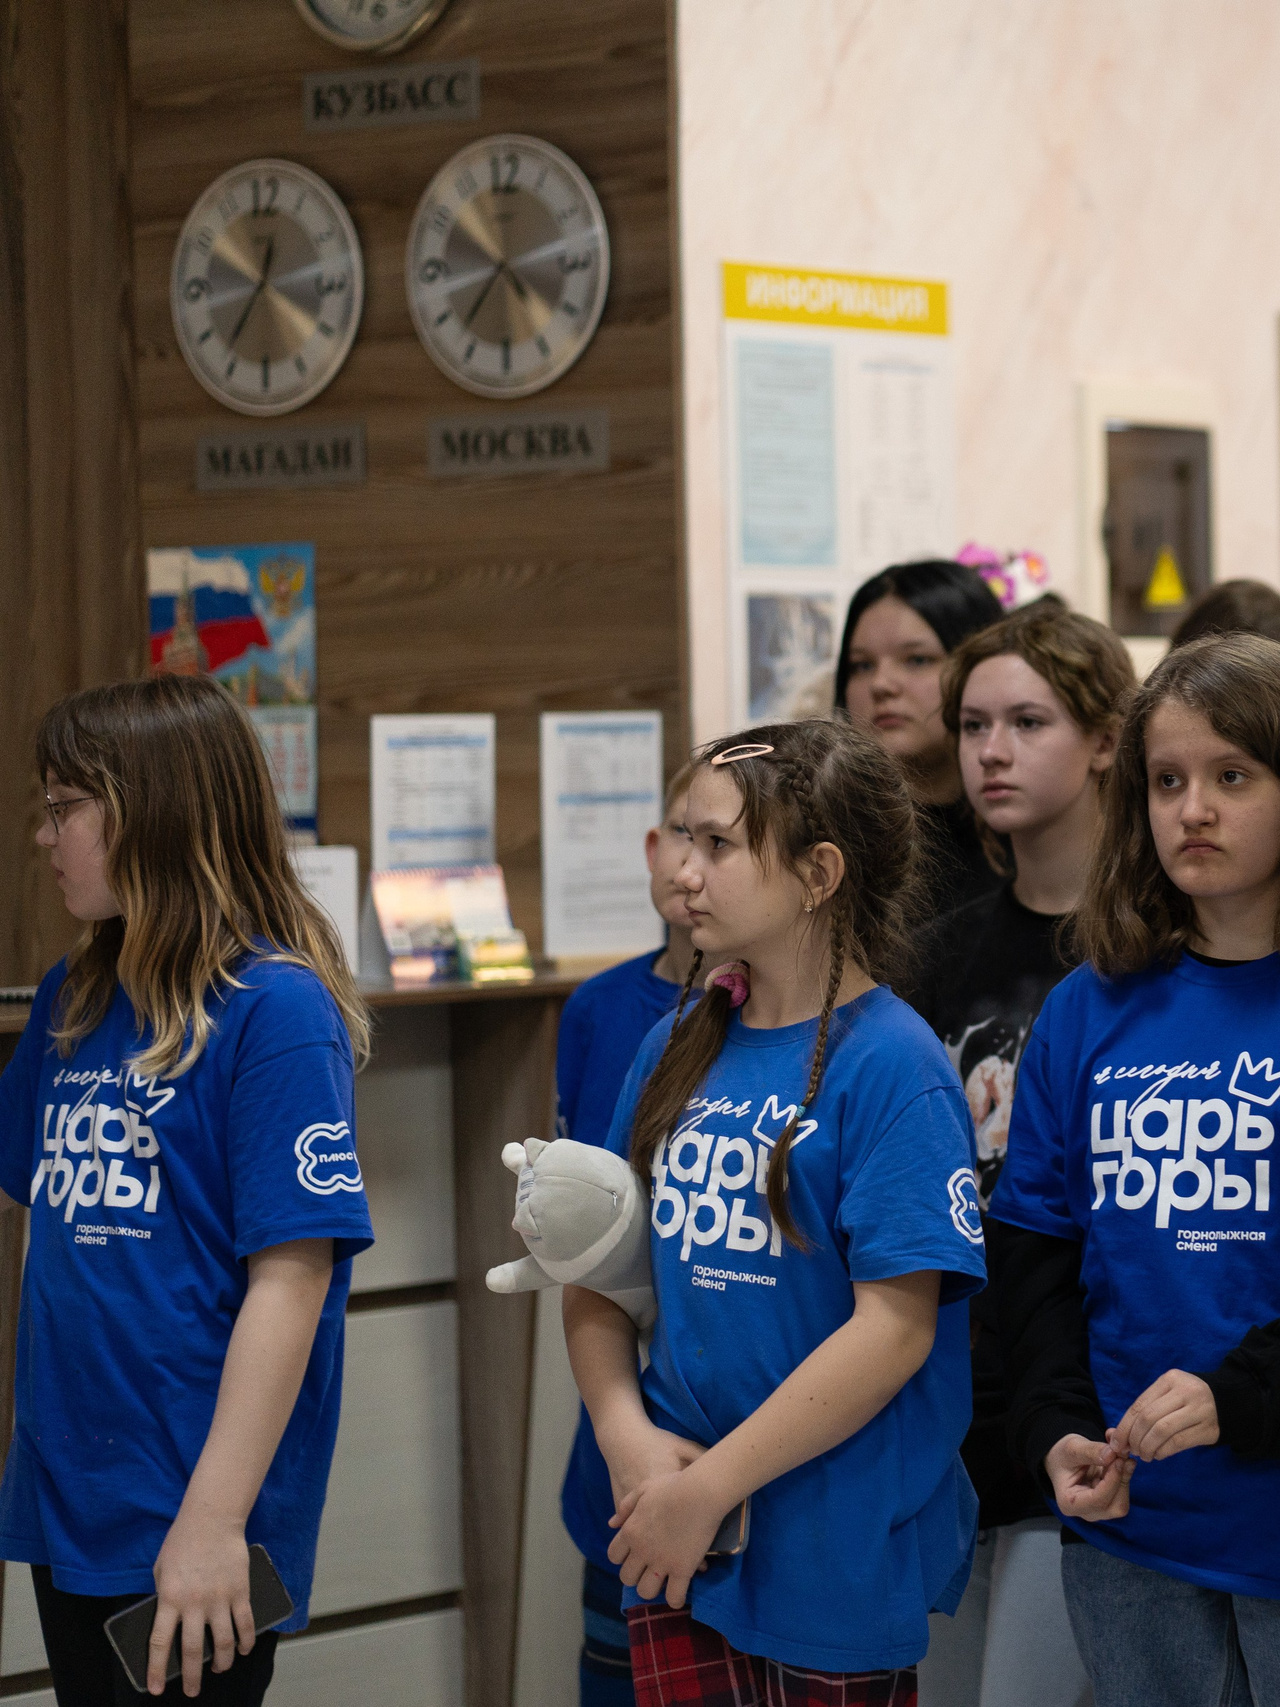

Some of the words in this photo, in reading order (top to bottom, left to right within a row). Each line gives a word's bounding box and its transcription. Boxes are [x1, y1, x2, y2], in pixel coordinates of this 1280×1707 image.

[312, 70, 472, 120] КУЗБАСС
[490, 152, 521, 194] 12
[251, 175, 280, 218] 12
[419, 257, 451, 284] 9
[557, 250, 592, 274] 3
[184, 276, 214, 302] 9
[314, 272, 347, 297] 3
[745, 271, 929, 325] ИНФОРМАЦИЯ
[206, 435, 354, 476] МАГАДАН
[440, 421, 595, 464] МОСКВА
[1093, 1066, 1113, 1085] я
[1114, 1061, 1222, 1119] сегодня
[319, 1151, 354, 1163] ПЛЮС
[75, 1224, 152, 1240] горнолыжная
[651, 1186, 782, 1262] оры
[1177, 1229, 1266, 1244] горнолыжная
[74, 1234, 107, 1246] смена
[1175, 1240, 1218, 1252] смена
[691, 1277, 727, 1292] смена
[693, 1264, 777, 1287] горнолыжная
